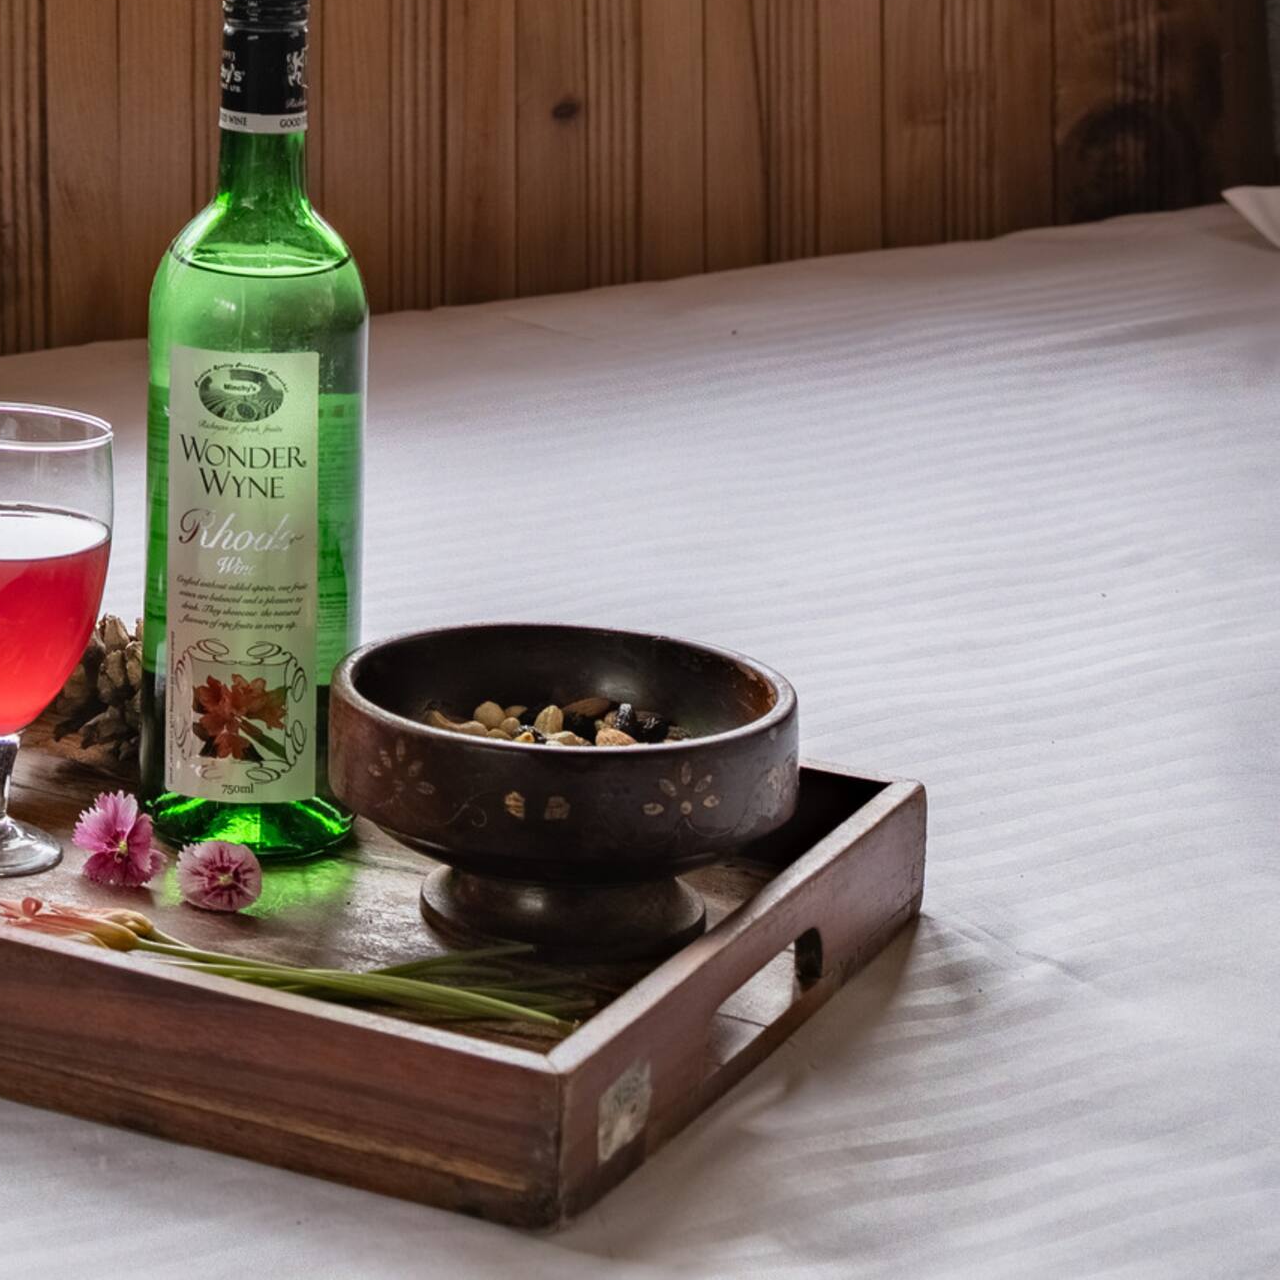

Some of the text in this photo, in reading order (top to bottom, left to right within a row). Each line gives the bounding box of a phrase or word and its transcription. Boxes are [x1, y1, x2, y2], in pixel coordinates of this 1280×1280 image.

[229, 115, 248, 127] WINE
[279, 117, 302, 129] GOOD
[180, 433, 308, 470] WONDER
[199, 467, 286, 500] WYNE
[200, 579, 227, 590] without
[228, 582, 252, 591] added
[209, 592, 243, 602] balanced
[242, 595, 259, 604] and
[262, 595, 294, 607] pleasure
[201, 603, 222, 617] They
[260, 608, 272, 617] the
[273, 606, 302, 617] natural
[263, 623, 284, 632] every
[221, 783, 255, 794] 750ml
